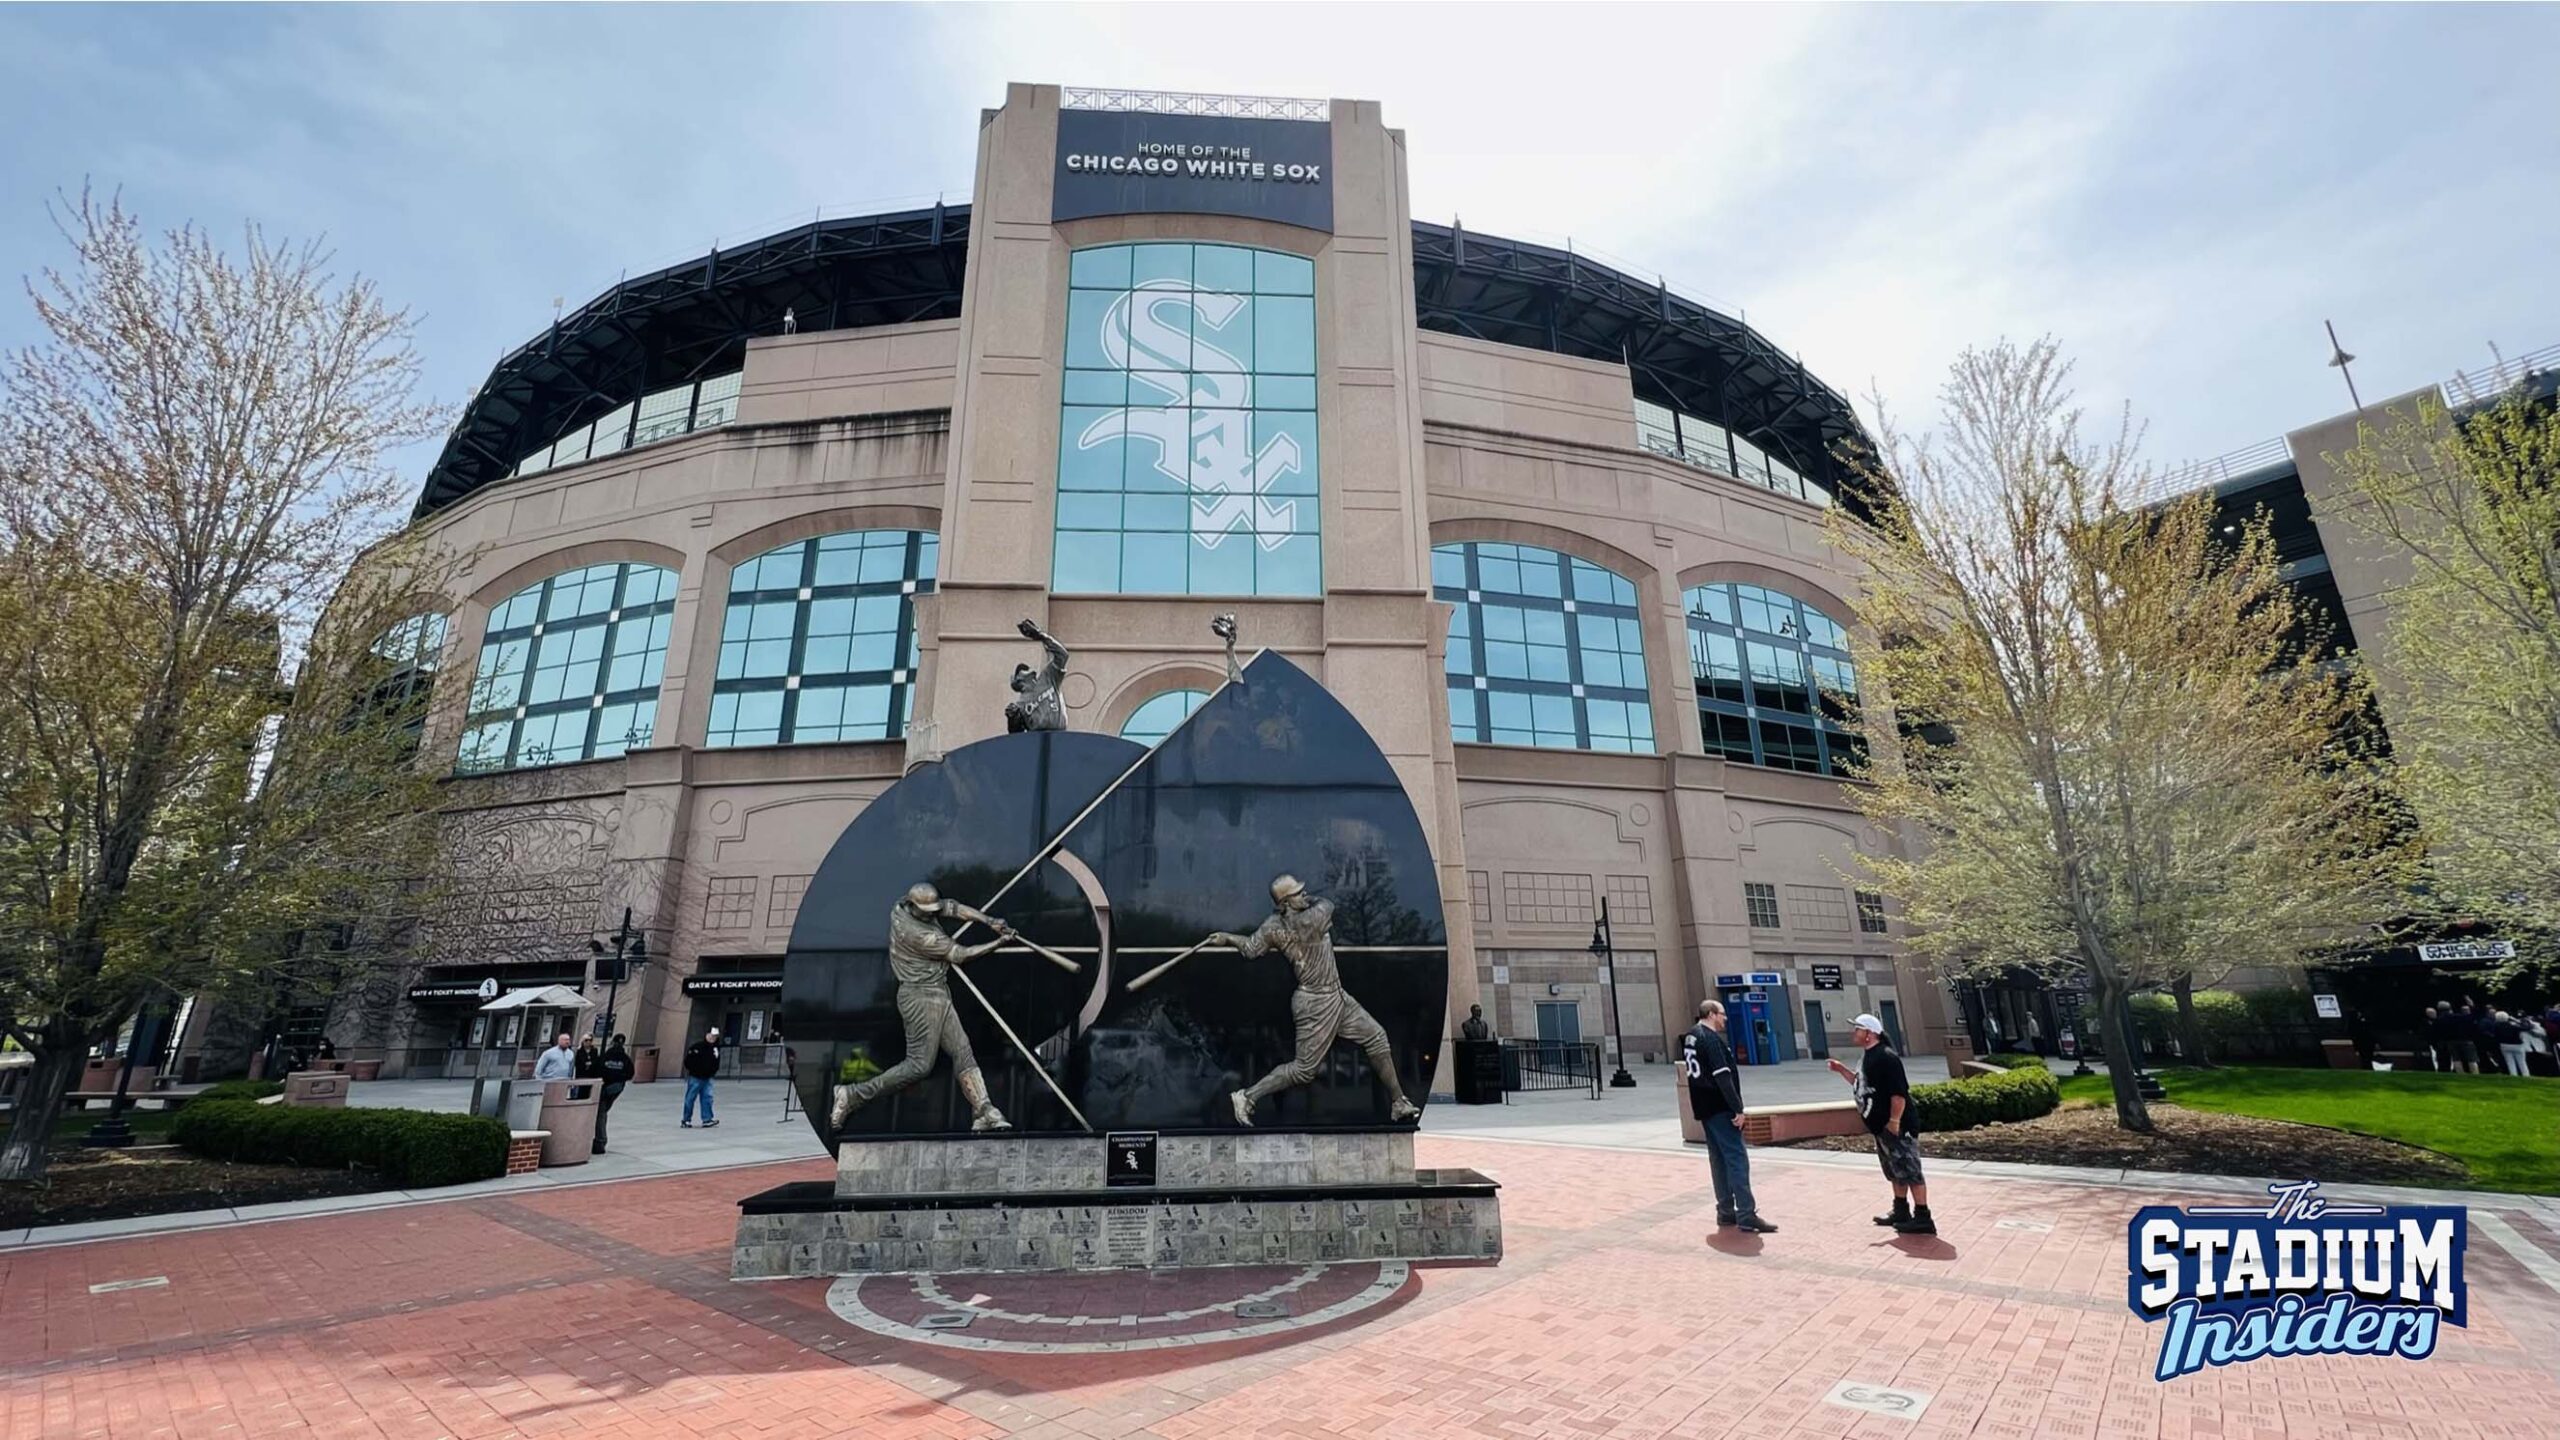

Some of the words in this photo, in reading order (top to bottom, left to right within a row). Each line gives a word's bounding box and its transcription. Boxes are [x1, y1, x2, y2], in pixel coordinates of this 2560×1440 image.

[1138, 142, 1186, 157] HOME
[1191, 144, 1214, 157] OF
[1220, 147, 1251, 159] THE
[1066, 154, 1179, 174] CHICAGO
[1186, 158, 1265, 178] WHITE
[1272, 163, 1321, 181] SOX
[2426, 942, 2506, 954] CHICAO
[2427, 951, 2474, 959] WHITE
